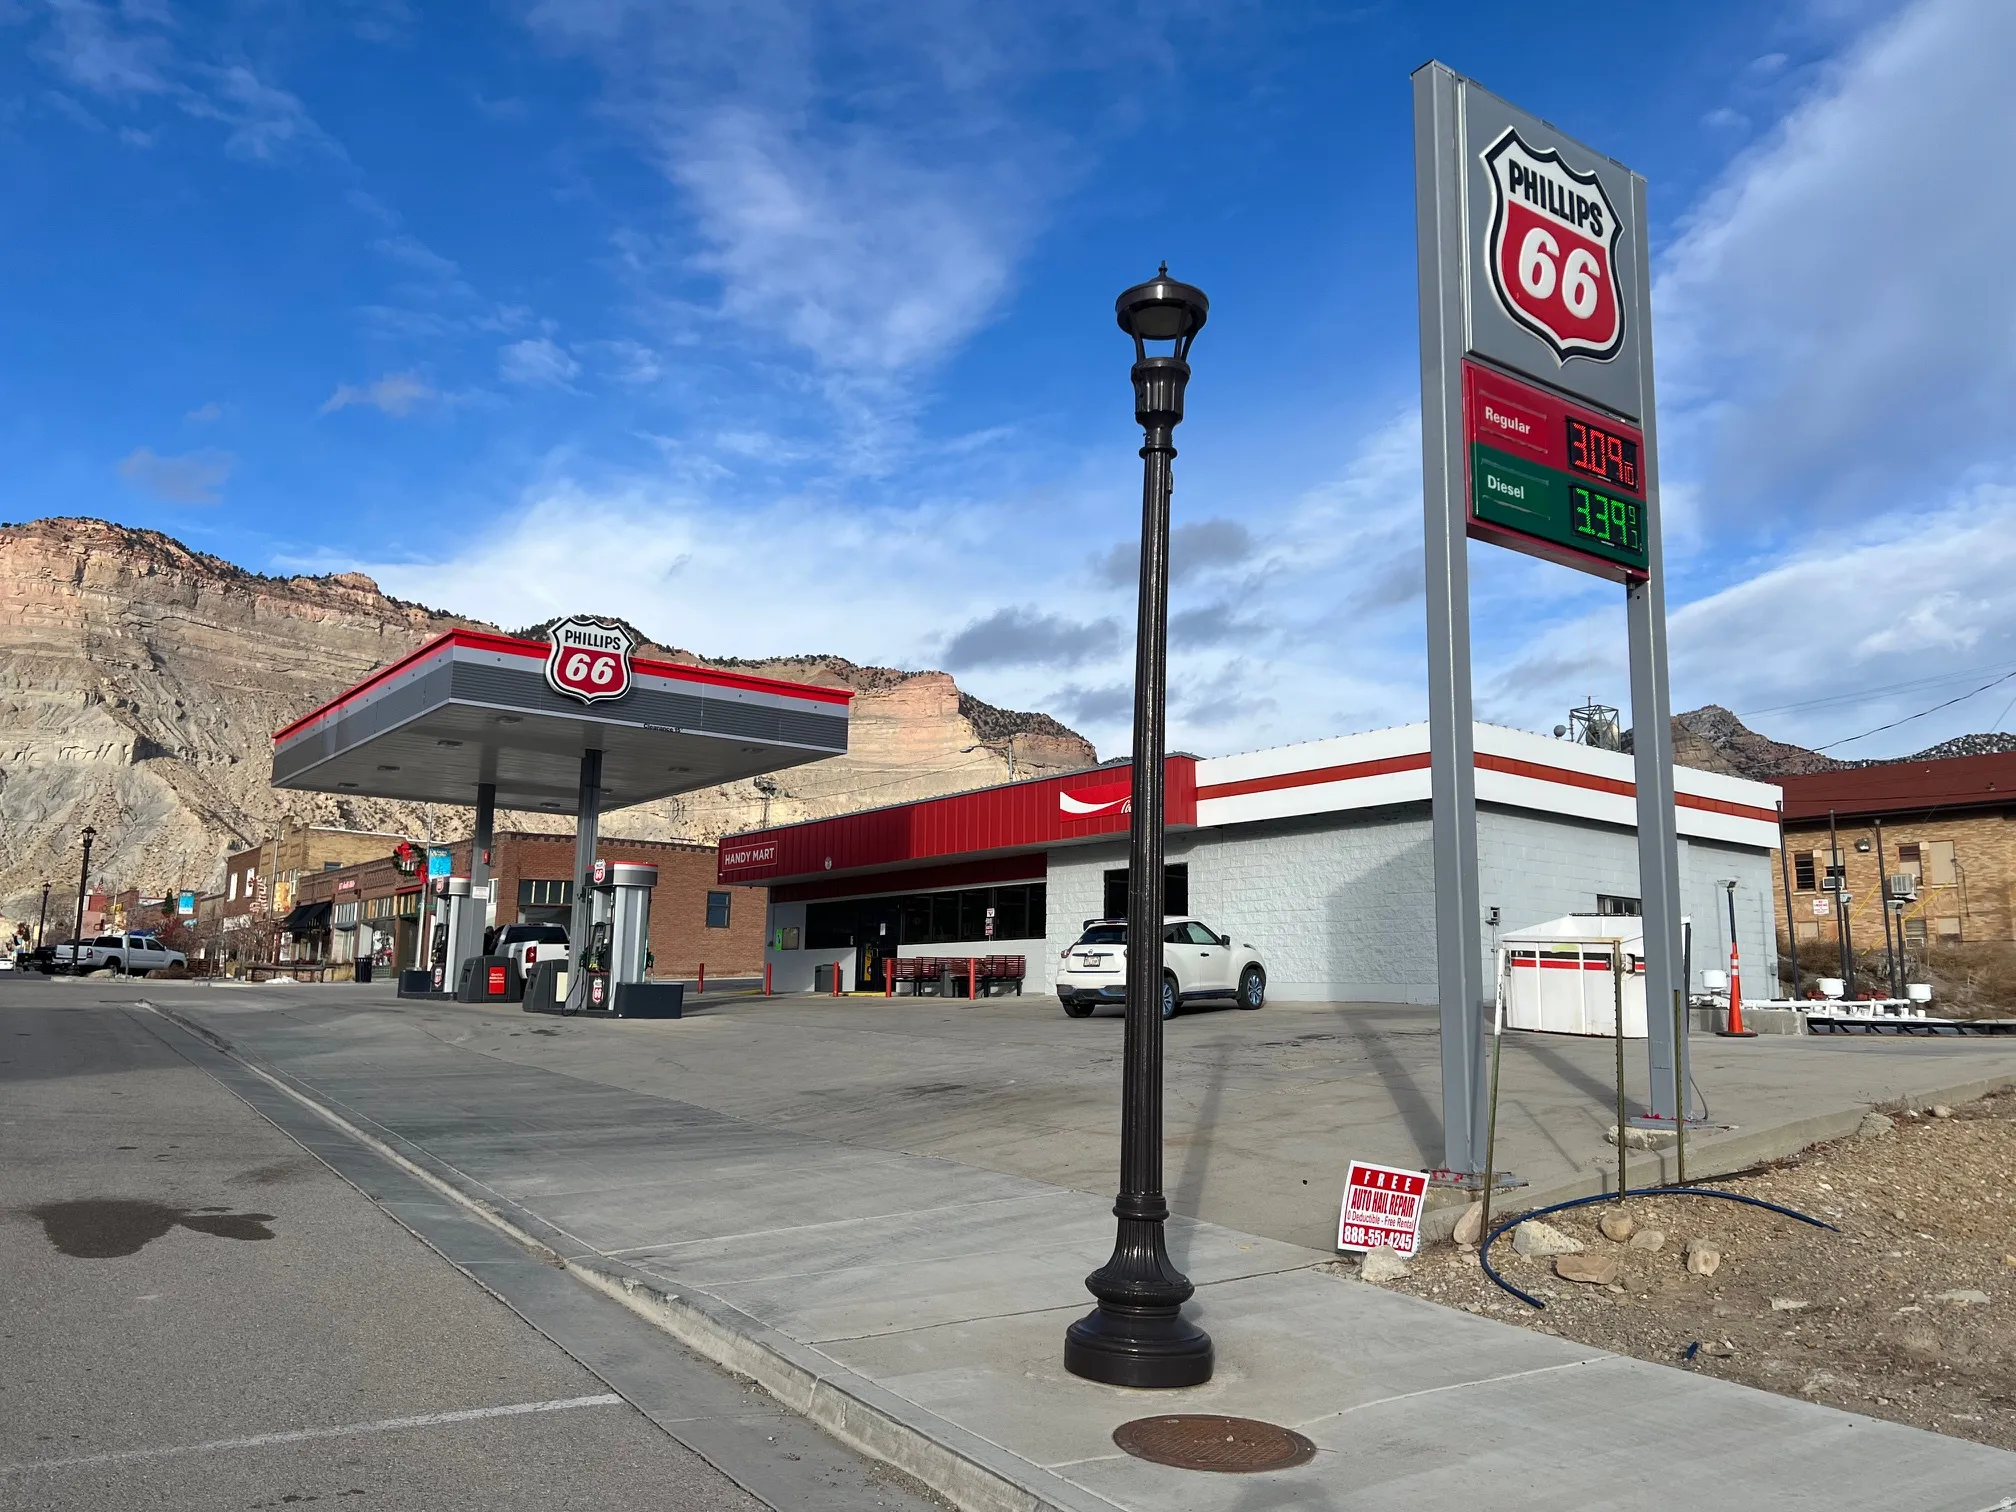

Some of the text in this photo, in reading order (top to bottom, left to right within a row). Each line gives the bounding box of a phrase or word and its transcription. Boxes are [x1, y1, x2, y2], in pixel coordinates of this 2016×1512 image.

[1508, 158, 1604, 238] PHILLIPS
[1518, 227, 1601, 320] 66
[1485, 406, 1531, 434] Regular
[1572, 422, 1624, 482] 3.09
[1487, 474, 1525, 499] Diesel
[564, 629, 621, 651] PHILLIPS
[565, 653, 616, 685] 66
[724, 847, 775, 866] HANDY MART
[1363, 1170, 1412, 1192] FREE
[1351, 1188, 1416, 1218] AUTO HAIL REPAIR
[1352, 1210, 1380, 1225] Deductible
[1384, 1215, 1396, 1227] Free
[1396, 1217, 1415, 1229] Rental
[1343, 1225, 1413, 1250] 888-551-4245
